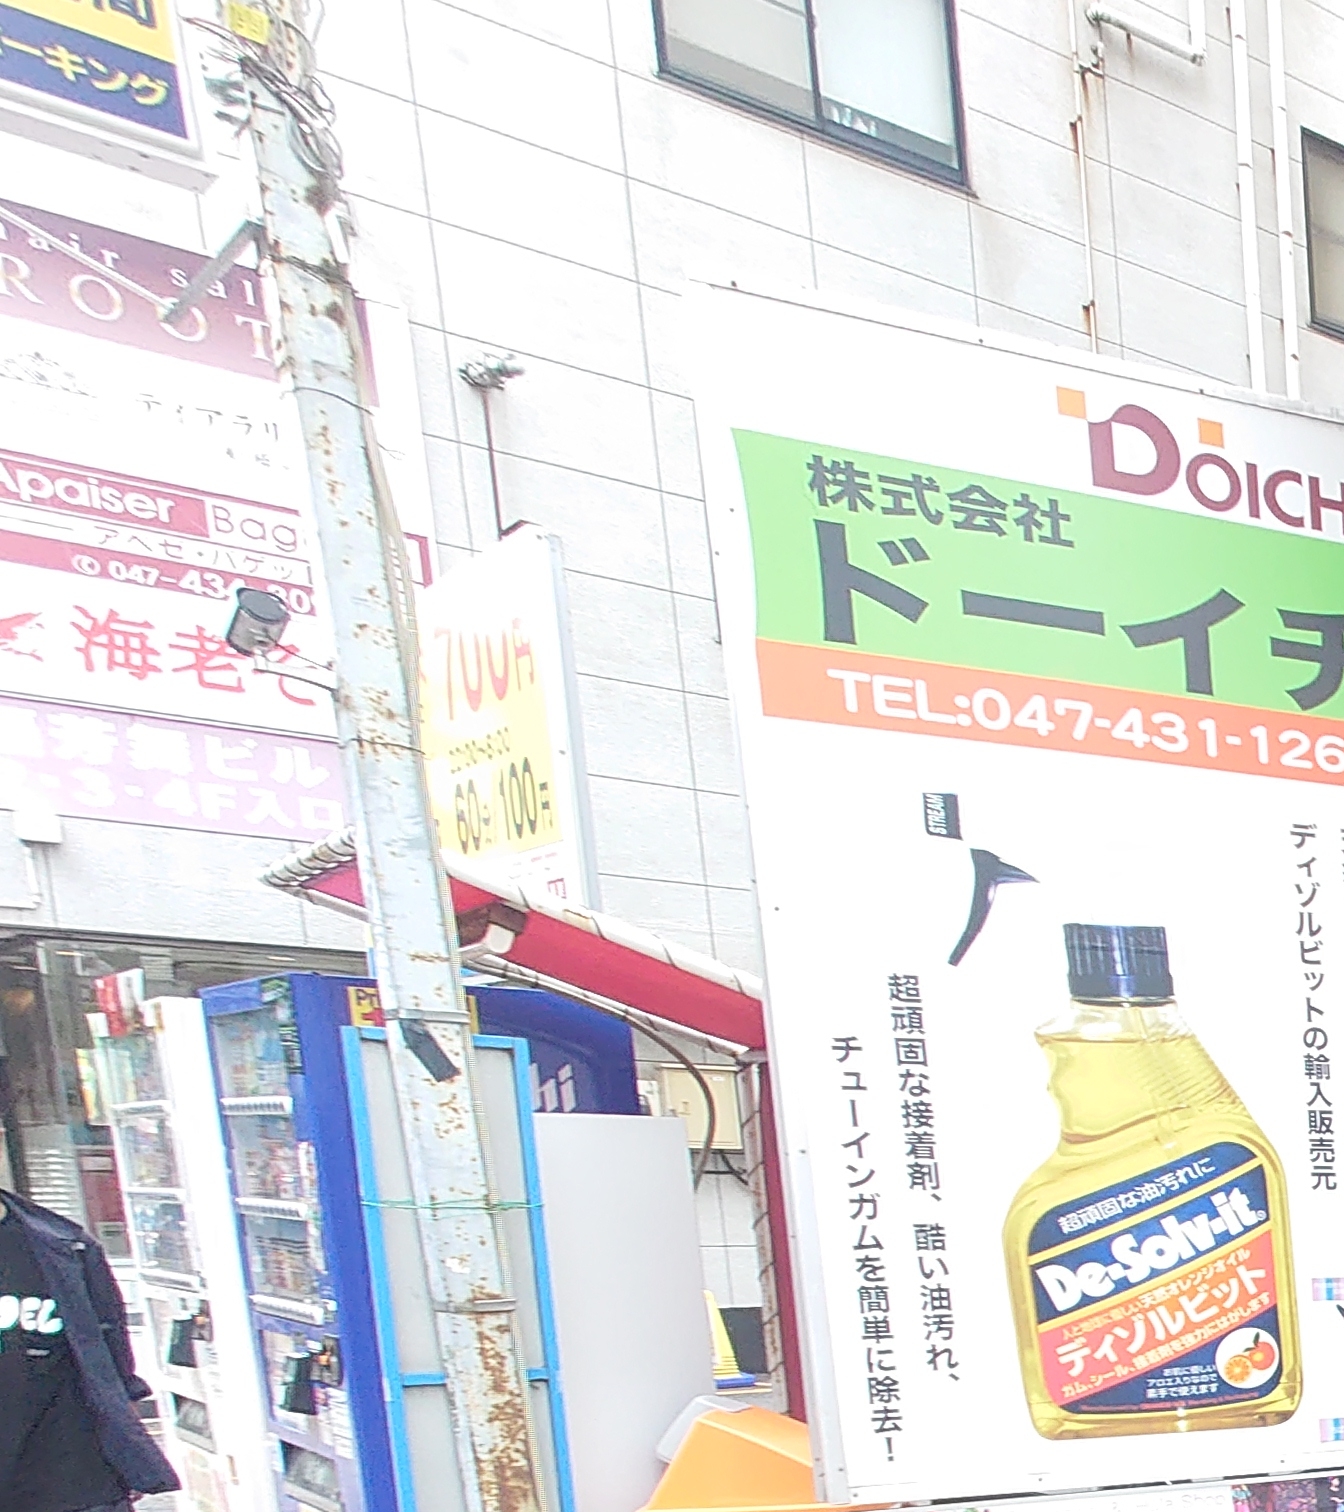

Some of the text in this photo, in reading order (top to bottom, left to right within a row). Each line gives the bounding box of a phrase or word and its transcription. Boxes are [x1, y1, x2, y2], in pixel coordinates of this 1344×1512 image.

[0, 34, 170, 107] ーキング
[806, 453, 1076, 549] 株式会社
[926, 793, 948, 836] STREAM
[1289, 822, 1338, 1192] ディゾルビットの輸入販売元
[1057, 1157, 1217, 1234] 超頑固な油汚れに
[1055, 1264, 1267, 1378] ディゾルビット
